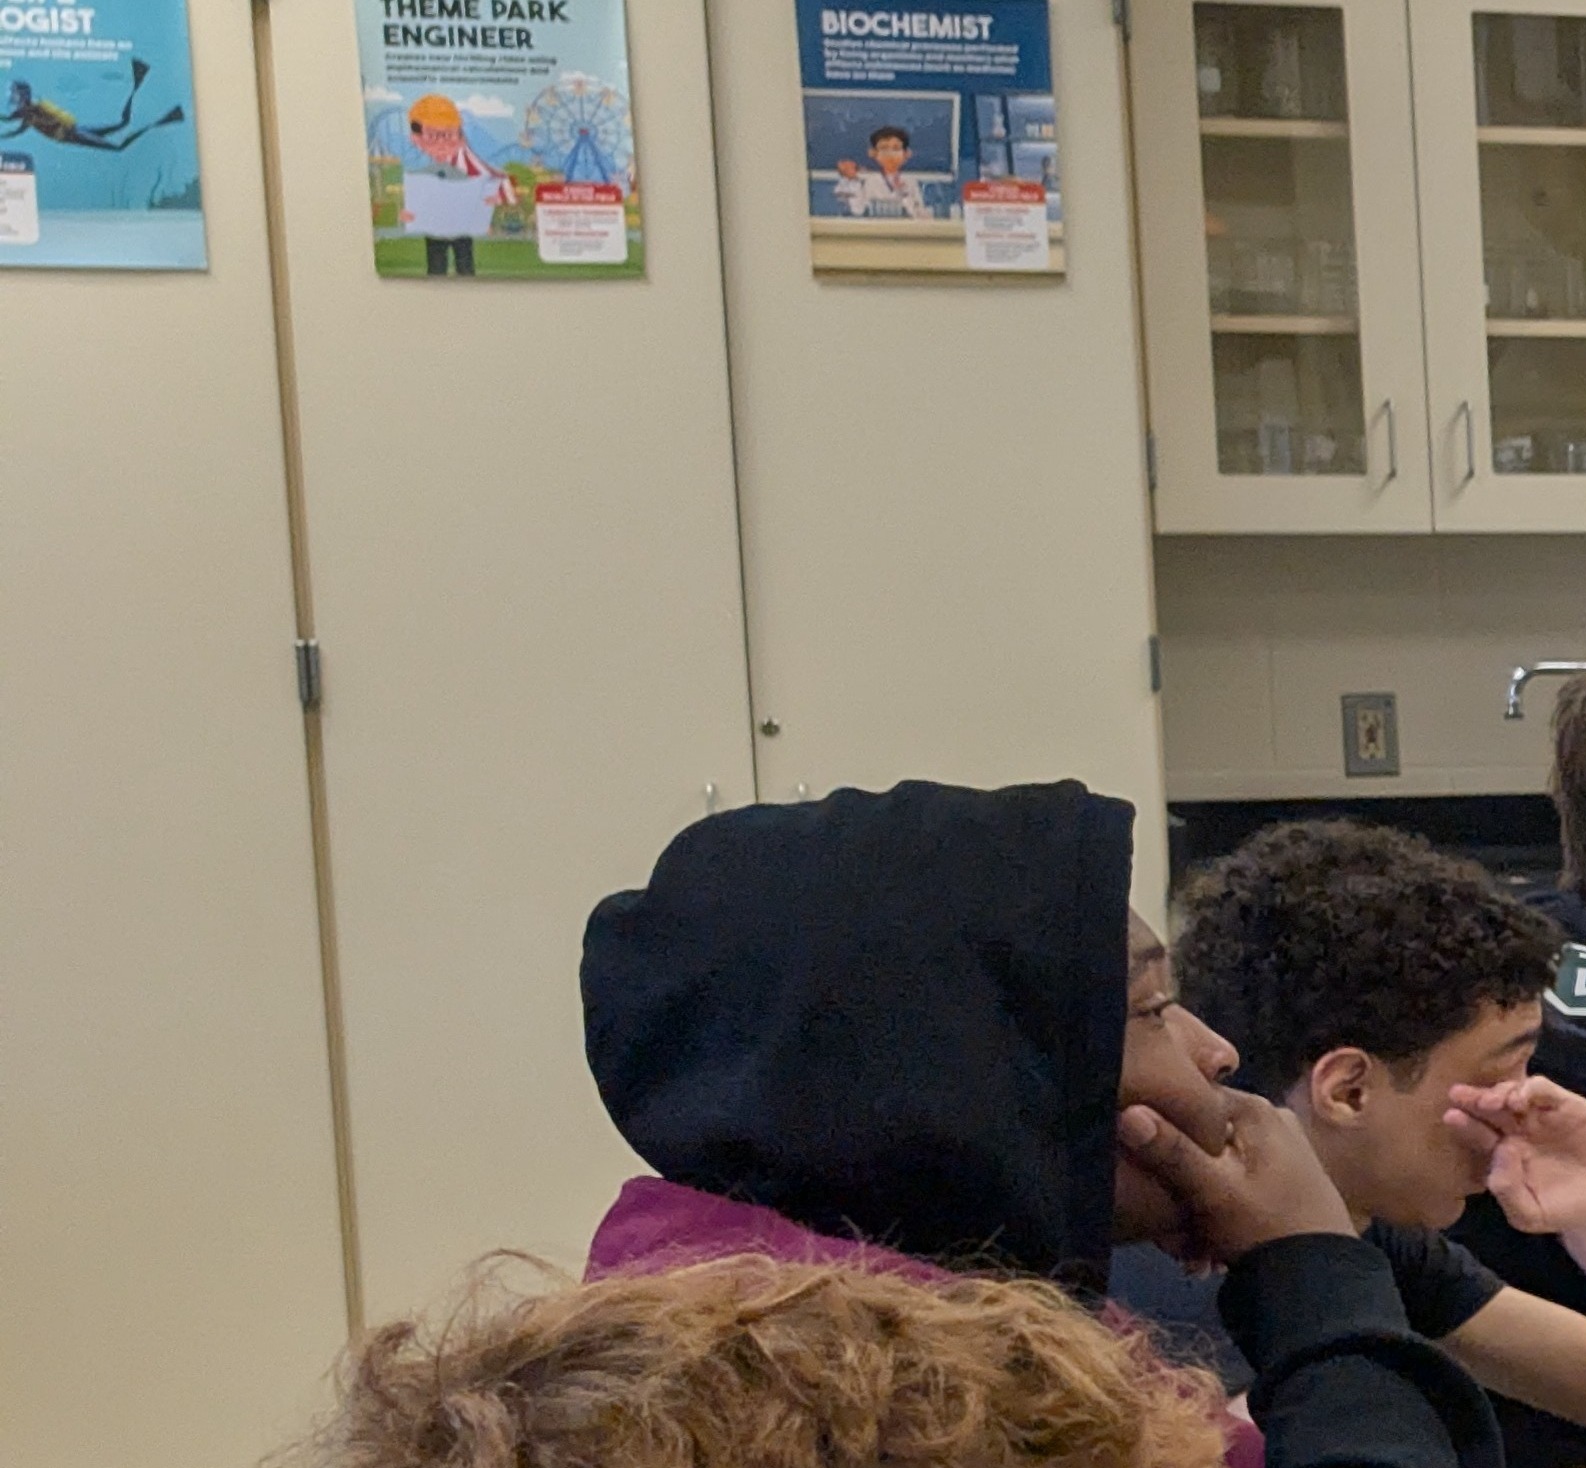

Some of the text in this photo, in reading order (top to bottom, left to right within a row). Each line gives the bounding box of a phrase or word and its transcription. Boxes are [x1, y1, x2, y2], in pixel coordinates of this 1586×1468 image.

[381, 0, 570, 22] THEME PARK
[383, 24, 533, 48] ENGINEER
[822, 10, 993, 39] BIOCHEMIST
